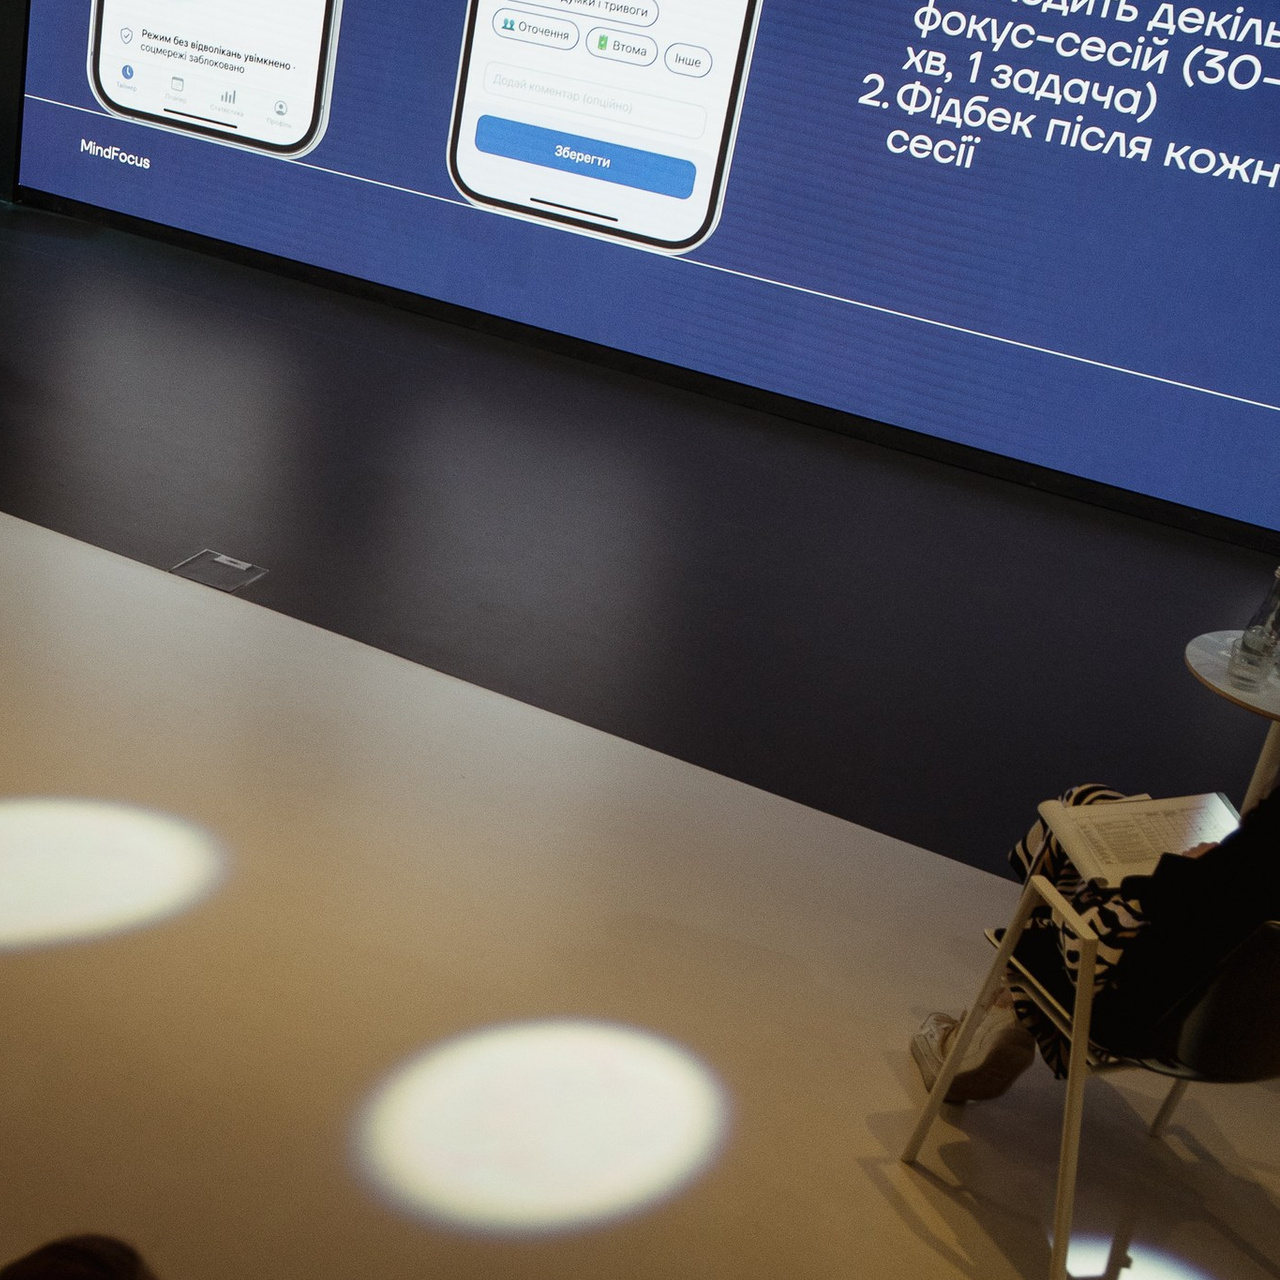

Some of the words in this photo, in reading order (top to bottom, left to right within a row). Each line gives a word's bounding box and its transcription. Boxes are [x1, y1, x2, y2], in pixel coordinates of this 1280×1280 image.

[604, 0, 648, 17] тривоги
[518, 21, 569, 41] Оточення
[140, 44, 187, 61] соцмережі
[189, 55, 245, 74] заблоковано
[141, 29, 172, 44] Режим
[173, 35, 189, 49] без
[191, 40, 242, 59] відволікань
[244, 53, 291, 71] увімкнено
[613, 41, 647, 57] Втома
[675, 53, 701, 68] Інше
[902, 46, 953, 84] хв,
[968, 51, 983, 83] 1
[991, 64, 1158, 123] задача)
[897, 79, 1037, 138] Фідбек
[1046, 116, 1153, 162] після
[80, 138, 151, 169] MindFocus
[554, 145, 611, 168] Зберегти
[886, 129, 981, 169] сесії
